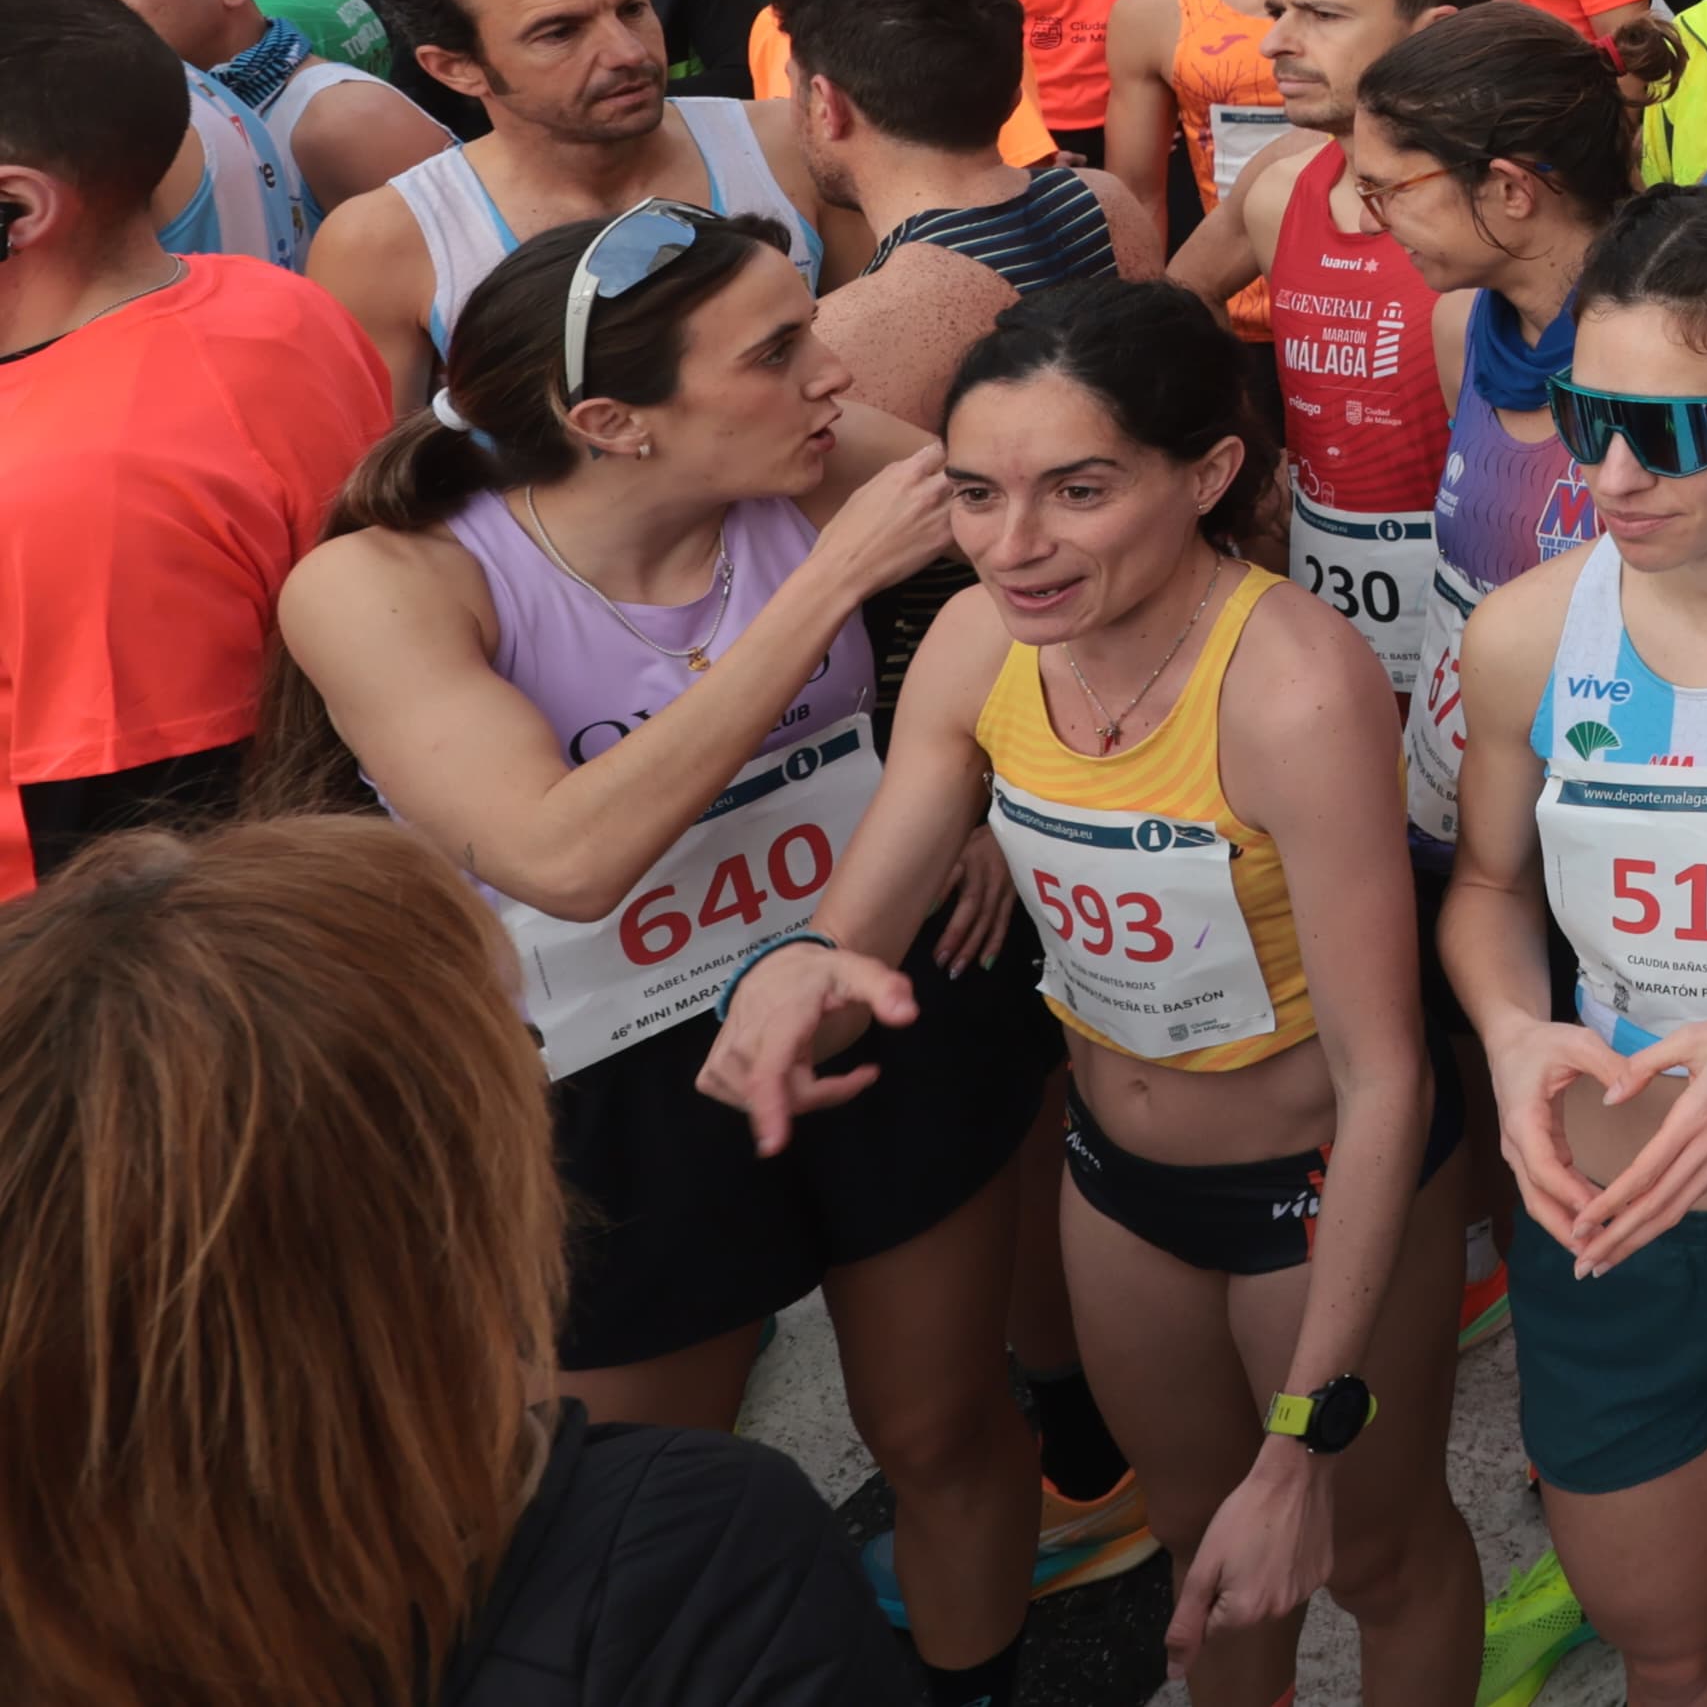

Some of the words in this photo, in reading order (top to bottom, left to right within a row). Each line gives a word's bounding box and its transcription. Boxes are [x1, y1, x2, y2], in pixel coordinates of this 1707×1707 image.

[1320, 253, 1364, 272] luanvi
[1290, 293, 1374, 321] GENERALI
[1321, 326, 1368, 345] MARATÓN
[1284, 335, 1368, 379] MÁLAGA
[1364, 406, 1391, 417] Ciudad
[1304, 554, 1401, 624] 230
[1567, 673, 1631, 702] vive
[618, 822, 835, 967] 640
[1031, 867, 1175, 963] 593
[642, 973, 689, 999] ISABEL
[689, 951, 736, 978] MARÍA
[1626, 953, 1670, 971] CLAUDIA
[1125, 981, 1157, 991] ROJAS
[1635, 980, 1698, 999] MARATÓN
[1112, 998, 1141, 1014] PEÑA
[1143, 1005, 1161, 1015] EL
[1162, 989, 1225, 1015] BASTÓN
[635, 1005, 673, 1031] MINI
